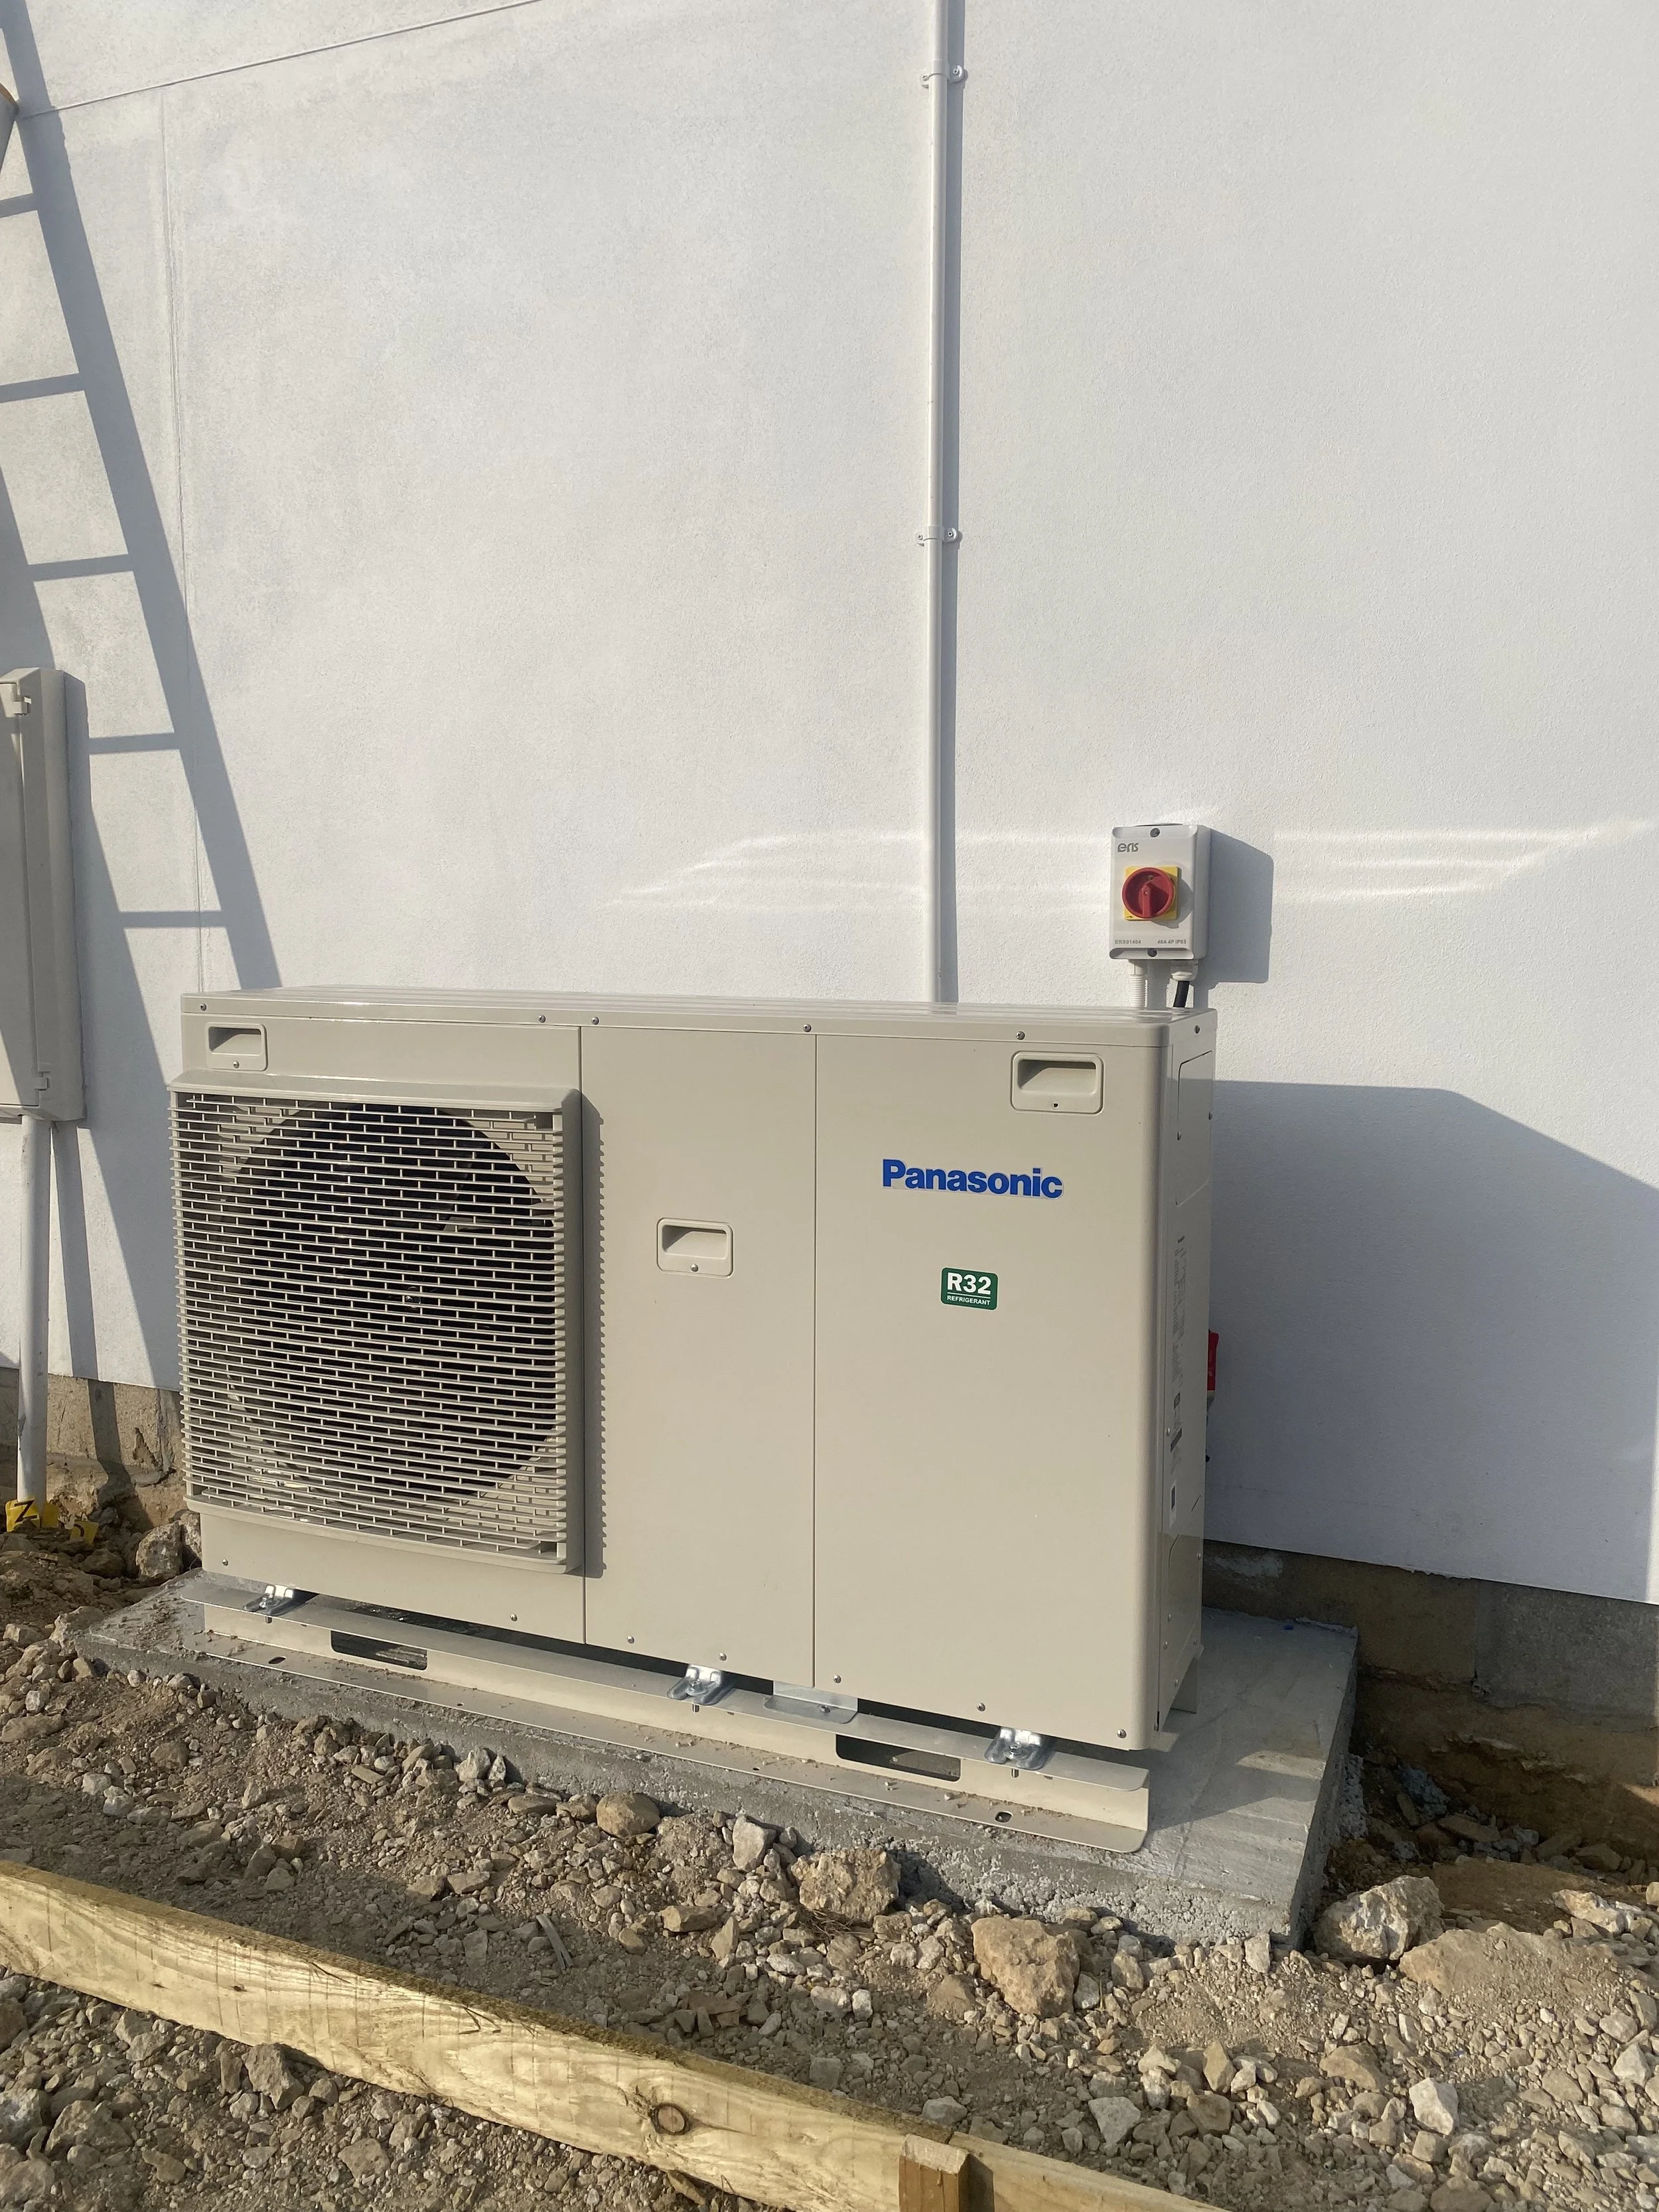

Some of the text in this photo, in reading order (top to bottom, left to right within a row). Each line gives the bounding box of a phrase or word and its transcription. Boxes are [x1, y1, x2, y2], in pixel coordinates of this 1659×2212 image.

[883, 1159, 1062, 1199] Panasonic
[947, 1272, 991, 1295] R32
[947, 1295, 991, 1305] REFRIGERANT
